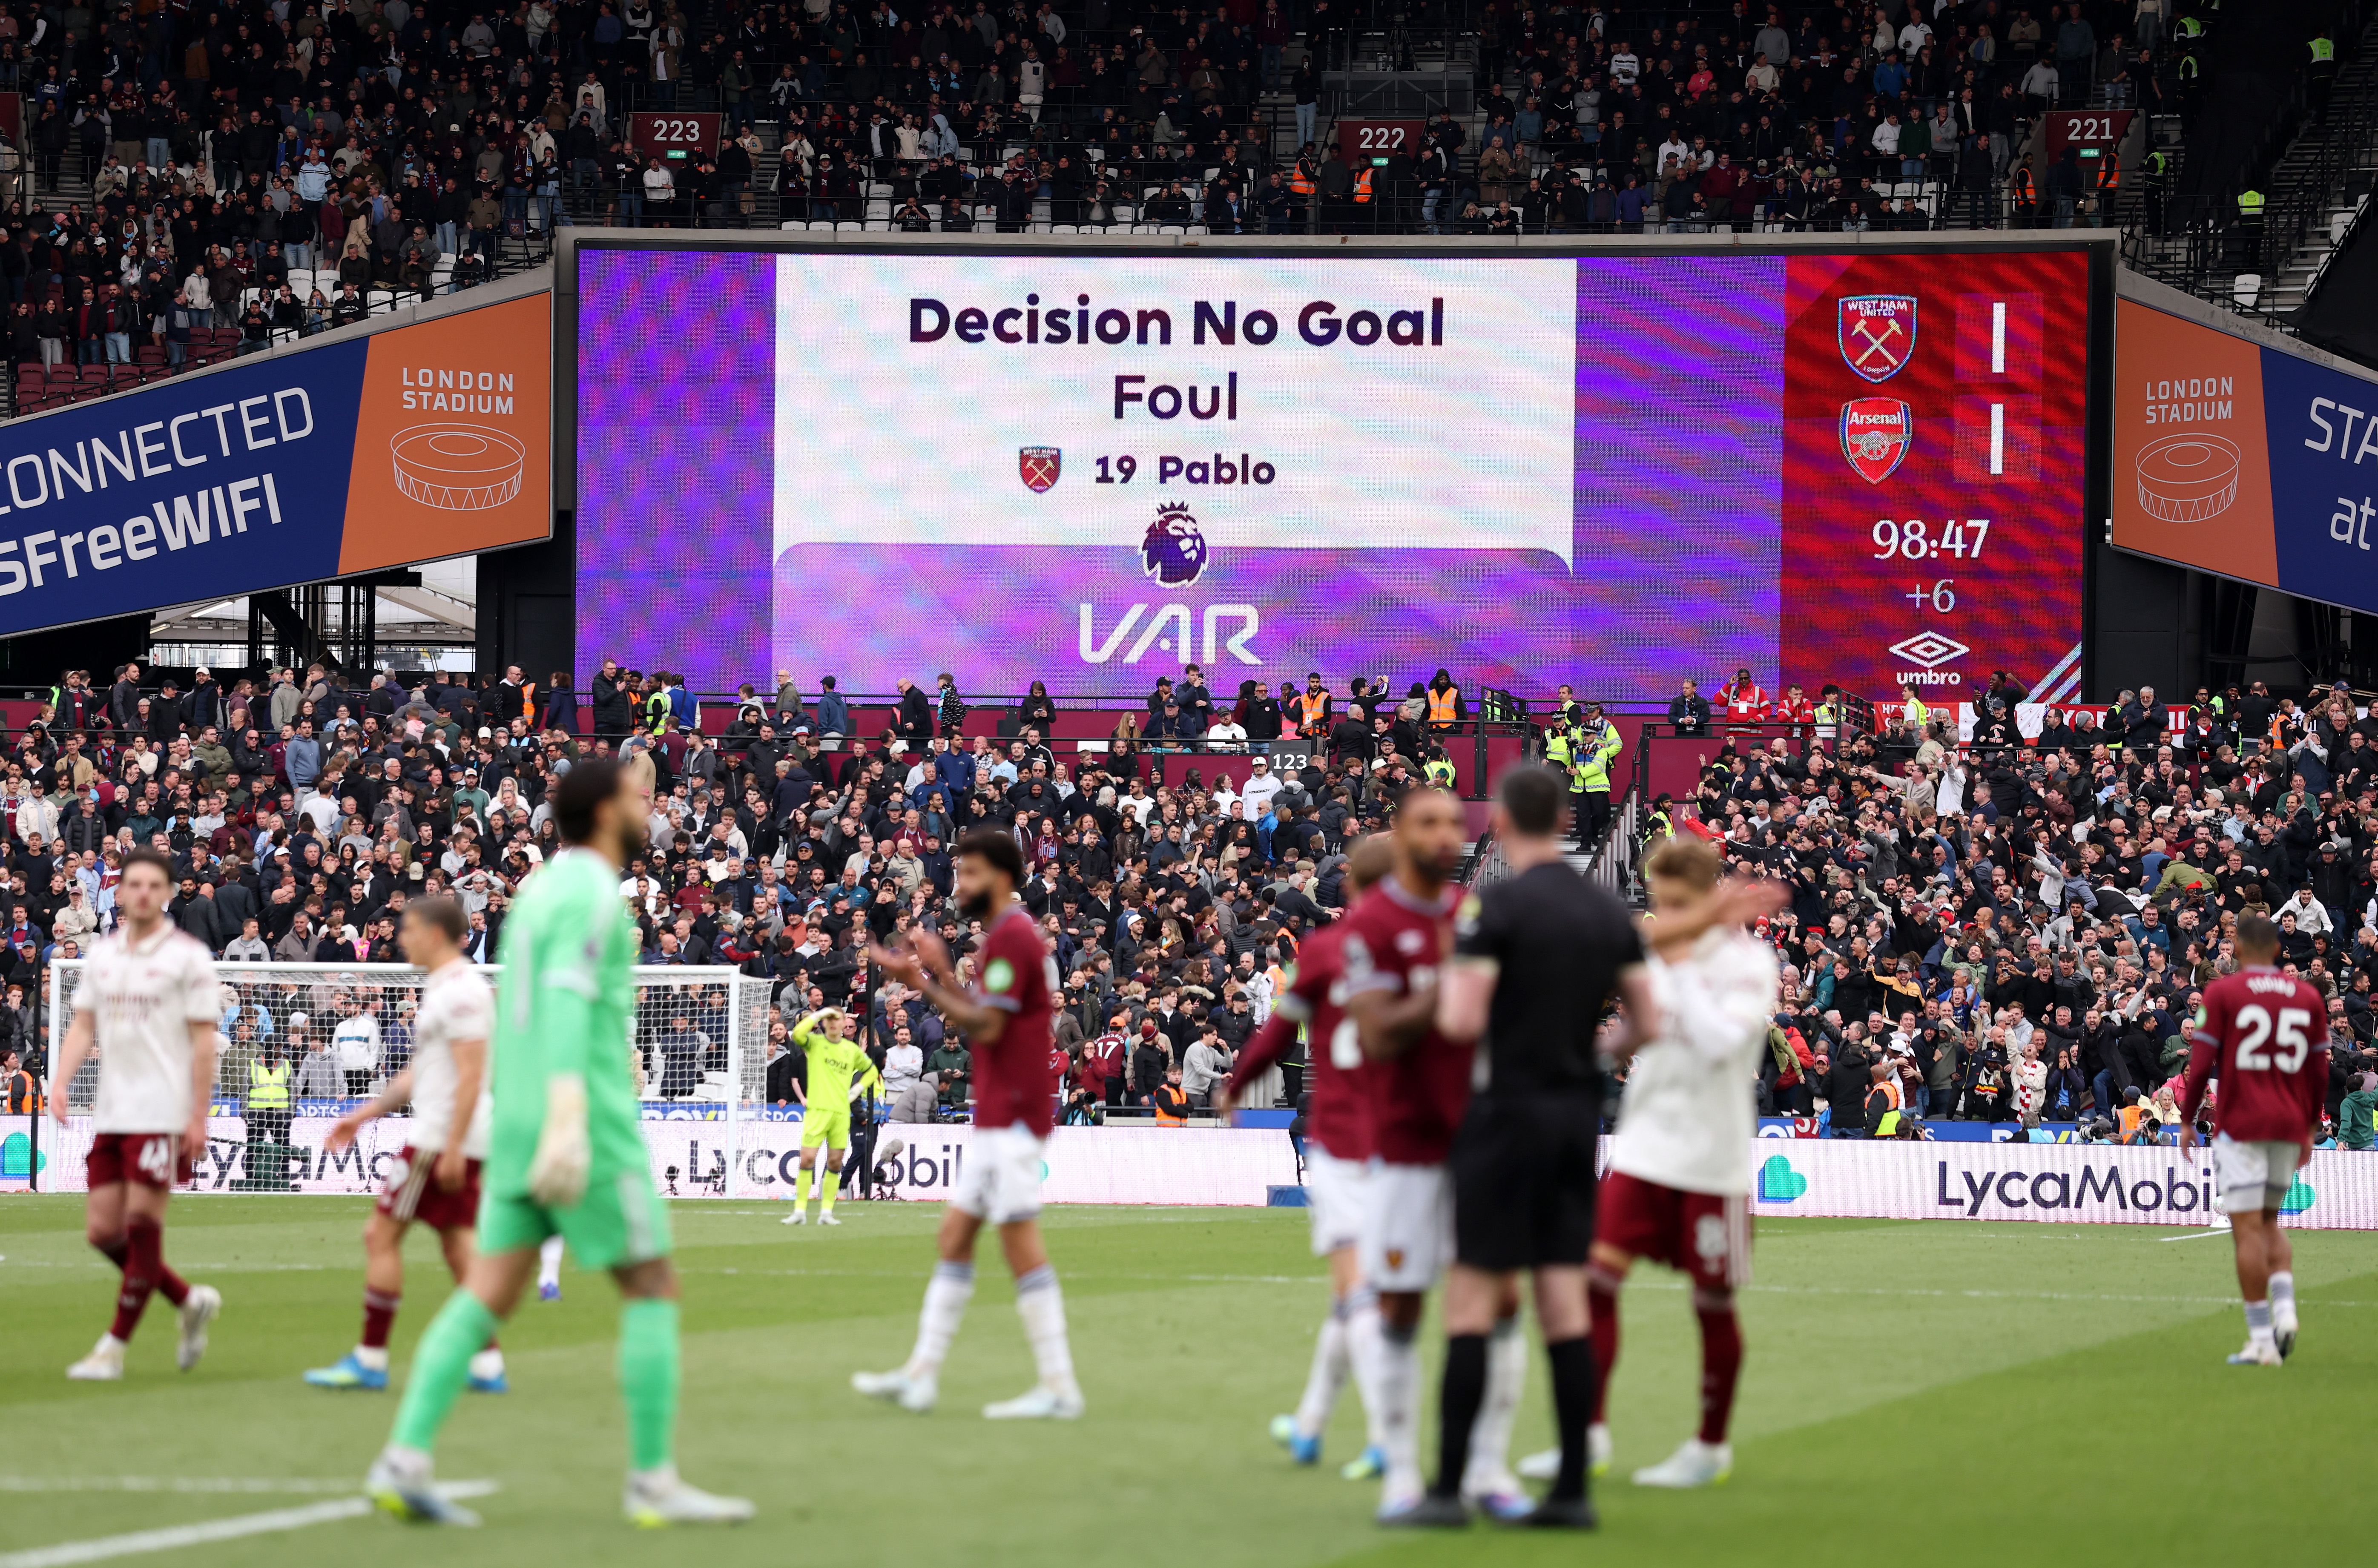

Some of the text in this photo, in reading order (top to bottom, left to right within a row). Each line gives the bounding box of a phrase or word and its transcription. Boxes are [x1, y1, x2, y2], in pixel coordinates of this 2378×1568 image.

[654, 120, 699, 142] 223
[1360, 127, 1404, 149] 222
[2068, 118, 2113, 140] 221
[1848, 300, 1907, 311] WEST HAM
[1860, 308, 1895, 317] UNITED
[910, 293, 1443, 347] Decision No Goal
[1992, 302, 2005, 373] 1
[402, 367, 513, 392] LONDON
[2146, 376, 2232, 400] LONDON
[402, 391, 513, 414] STADIUM
[1114, 371, 1237, 420] Foul
[1849, 411, 1901, 425] Arsenal
[2146, 400, 2232, 424] STADIUM
[0, 387, 313, 515] ONNECTED
[1990, 404, 2004, 474] 1
[1096, 453, 1275, 485] 19 Pablo
[2330, 497, 2376, 550] at
[1873, 520, 1990, 560] 98:47
[1906, 579, 1955, 613] +6
[1079, 603, 1262, 664] VAR
[1896, 669, 1961, 685] umbro
[1273, 753, 1307, 770] 123
[1097, 1041, 1119, 1060] 17
[2235, 1004, 2311, 1074] 25
[1939, 1161, 2210, 1217] LycaMobi
